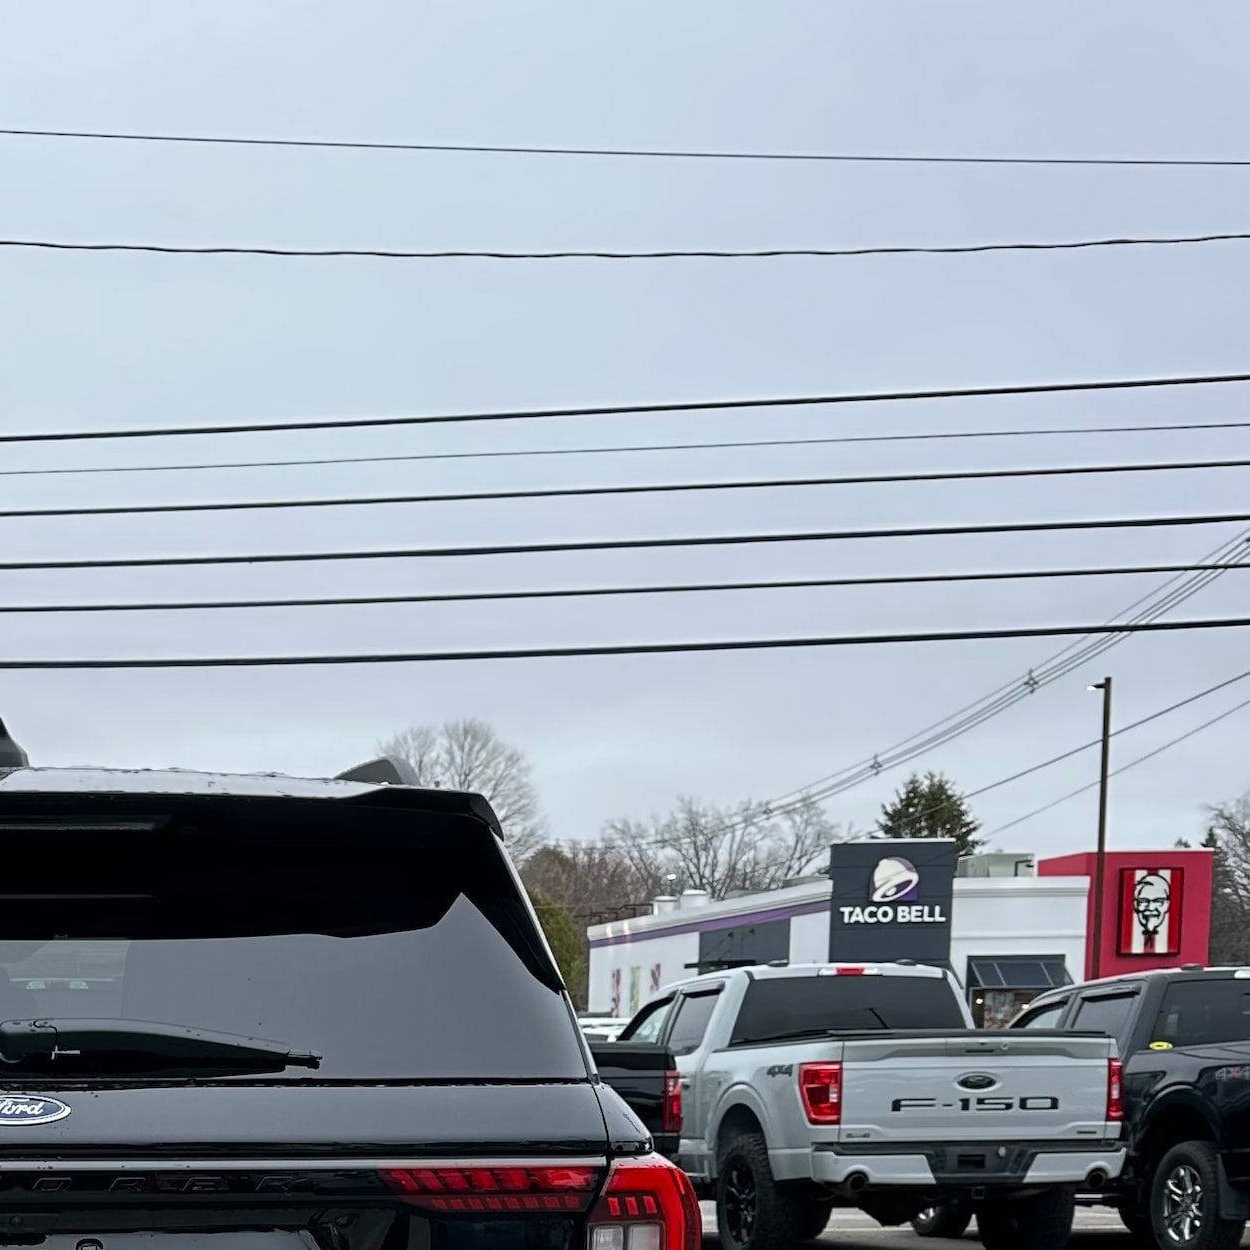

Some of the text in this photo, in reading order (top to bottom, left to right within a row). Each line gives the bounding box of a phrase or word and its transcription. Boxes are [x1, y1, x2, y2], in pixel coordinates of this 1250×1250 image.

[839, 905, 947, 924] TACO BELL
[891, 1096, 1059, 1112] F-150
